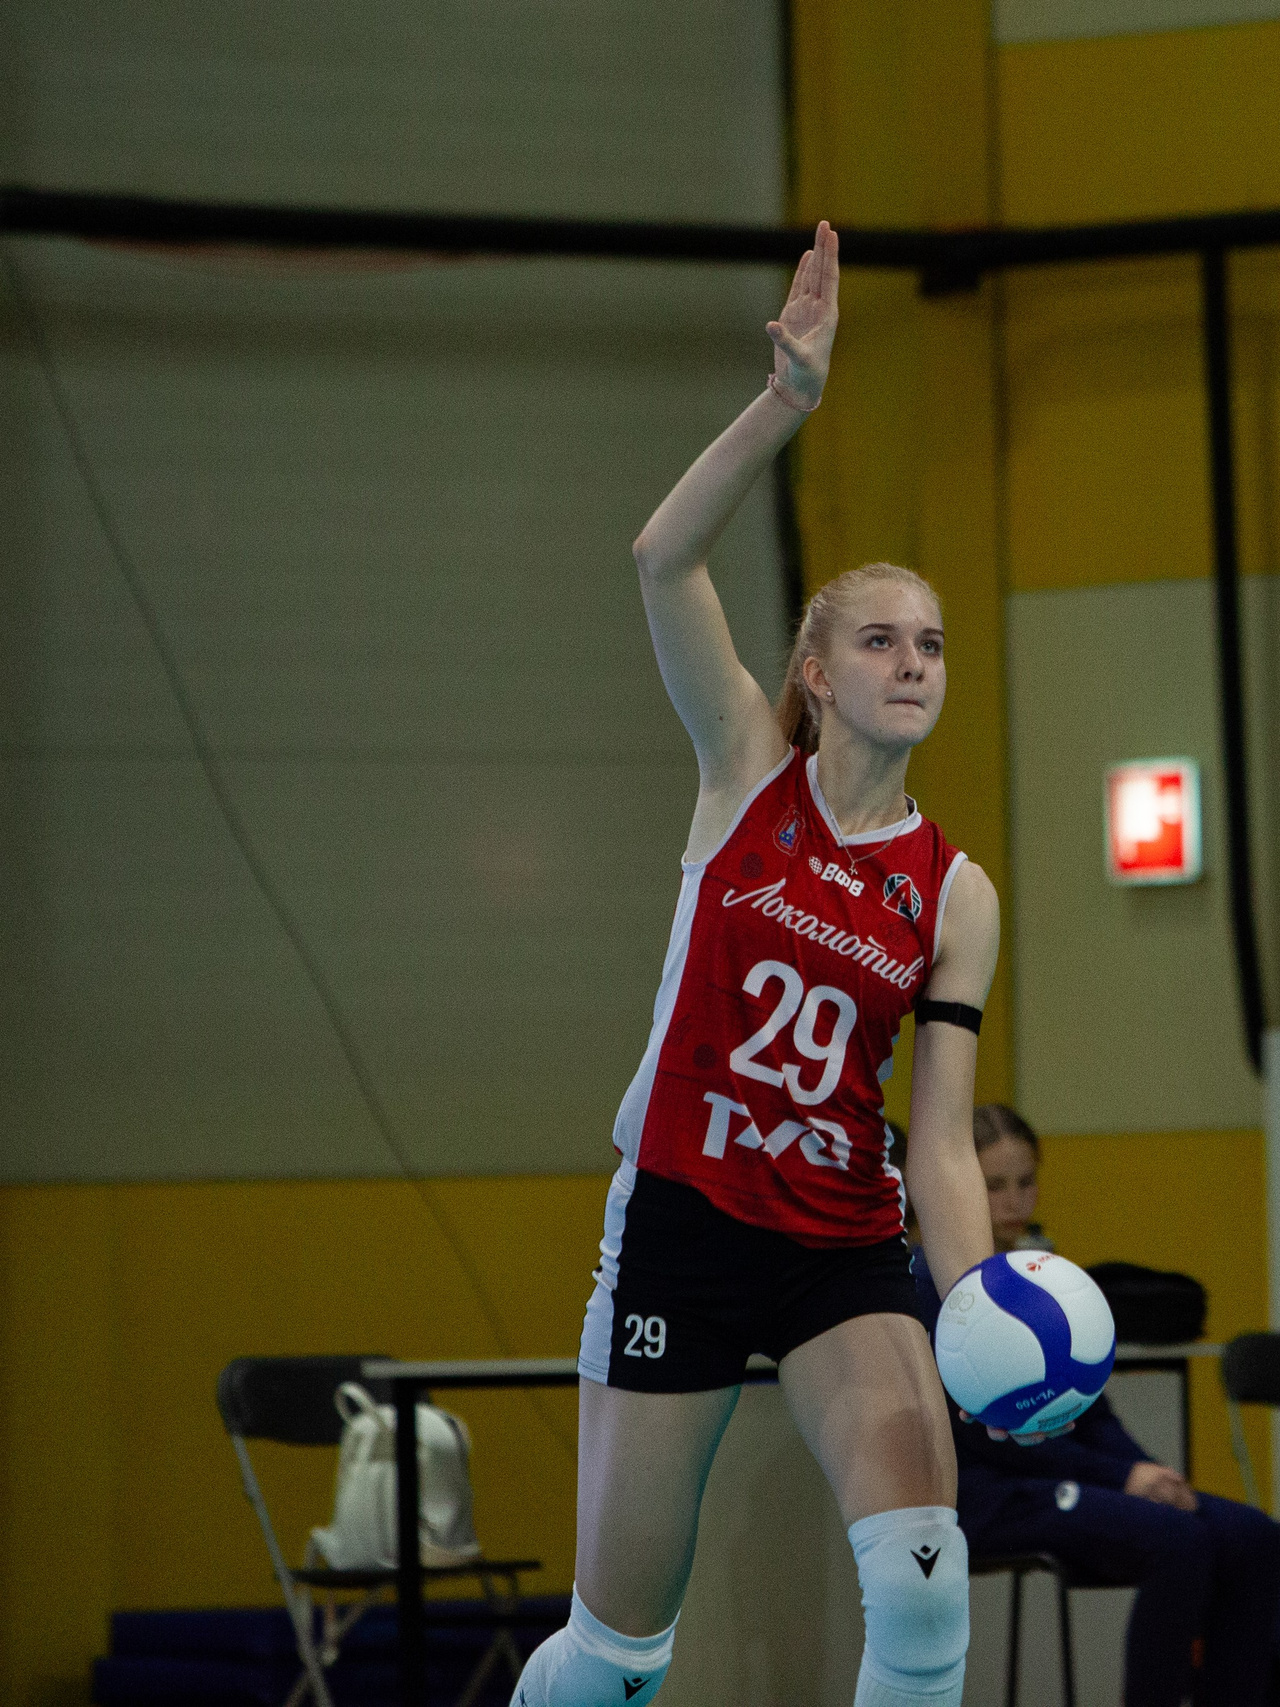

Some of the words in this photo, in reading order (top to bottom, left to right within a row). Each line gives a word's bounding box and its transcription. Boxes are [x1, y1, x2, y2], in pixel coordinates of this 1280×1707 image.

[820, 862, 865, 898] ВФВ
[722, 877, 926, 990] Локомотив
[729, 959, 858, 1106] 29
[623, 1313, 667, 1359] 29
[1015, 1389, 1056, 1411] VL-100
